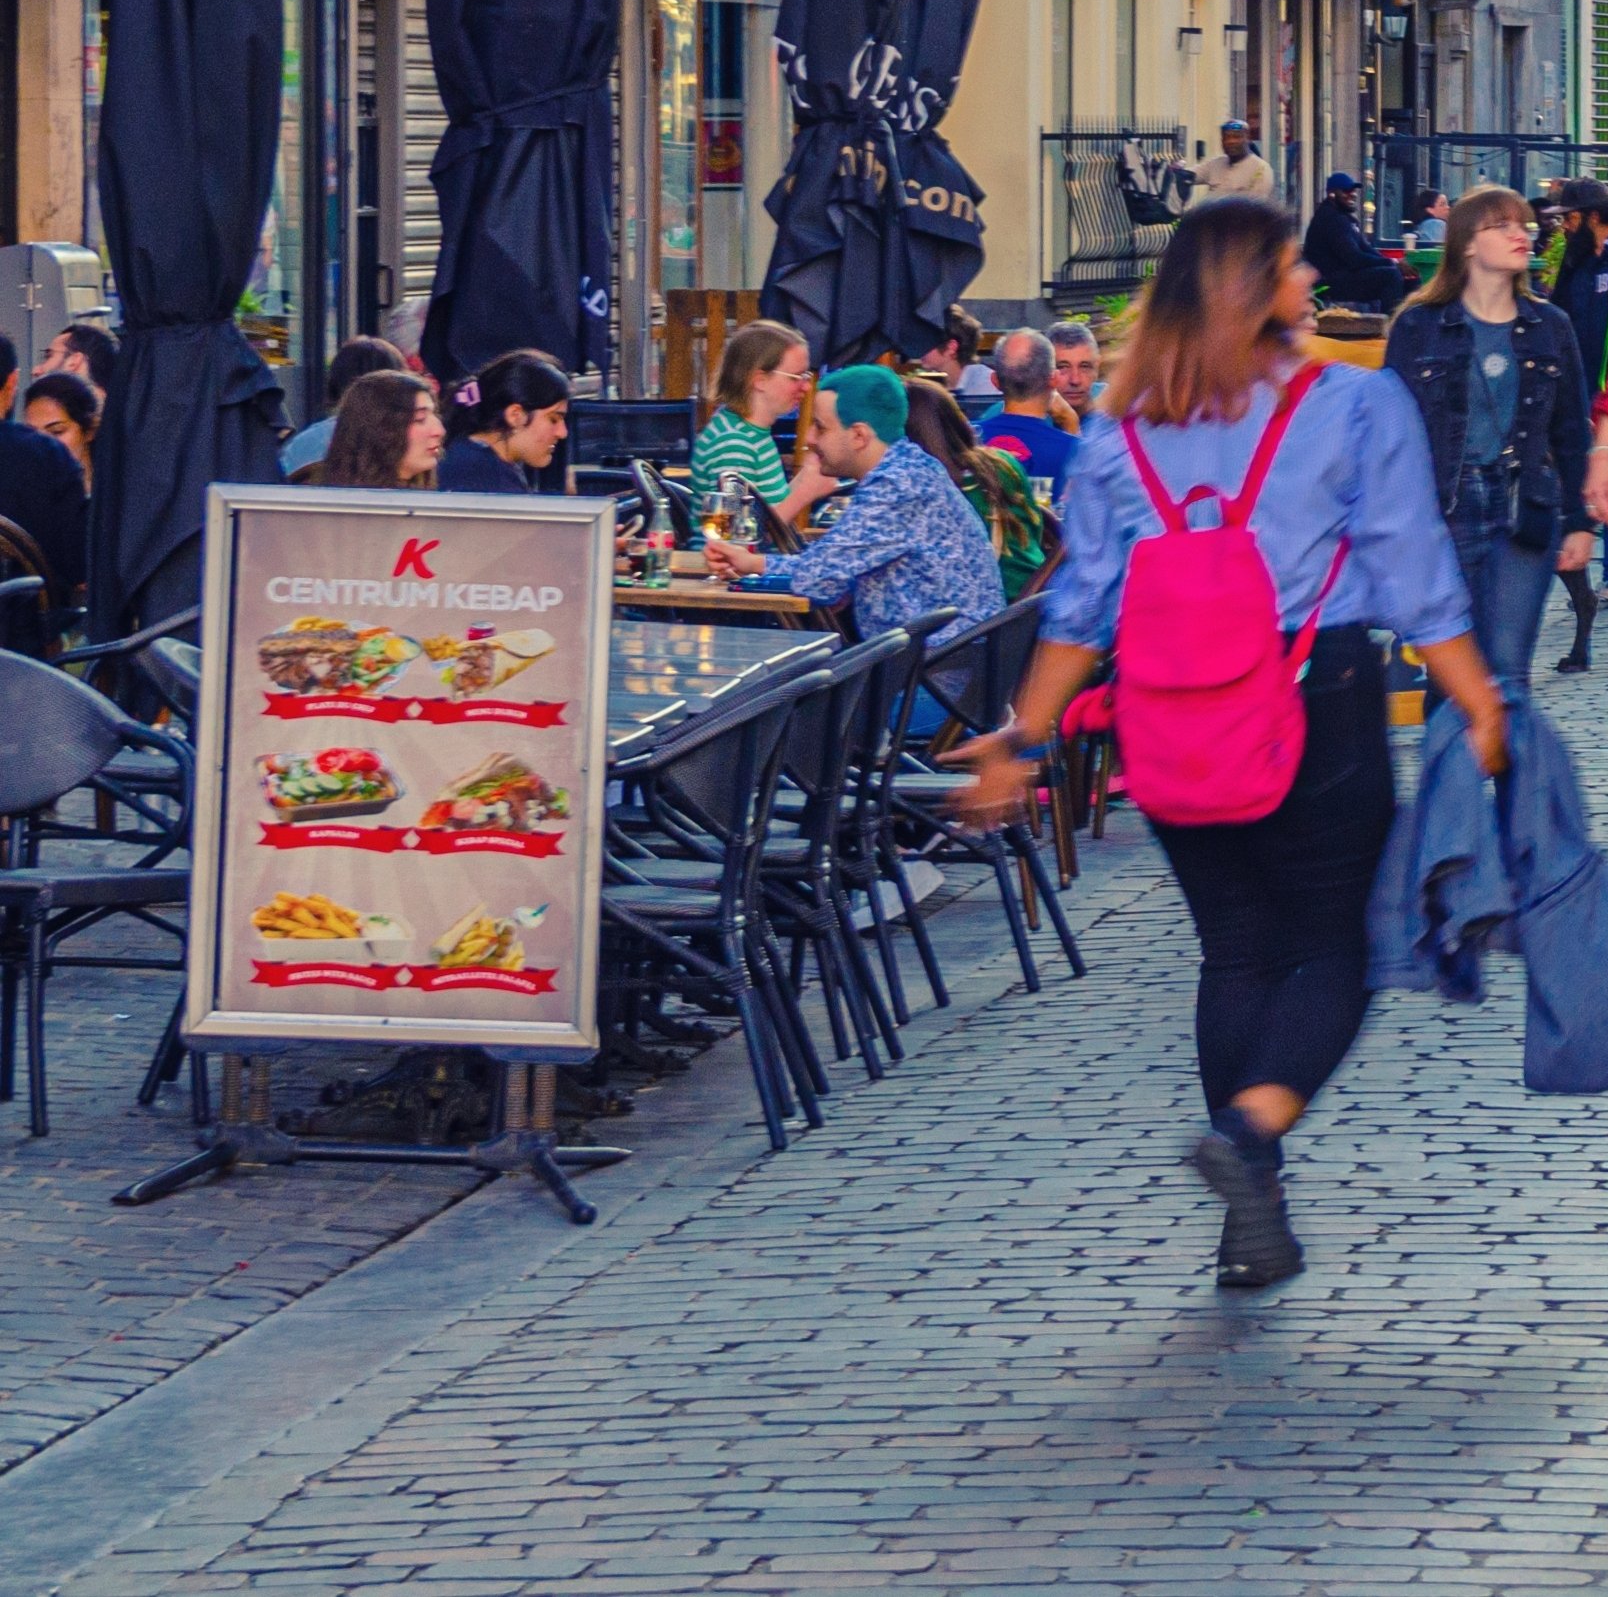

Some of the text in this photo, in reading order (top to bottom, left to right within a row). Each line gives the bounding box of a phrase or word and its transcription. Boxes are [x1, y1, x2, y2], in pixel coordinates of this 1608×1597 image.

[392, 538, 442, 580] K
[266, 576, 564, 613] CENTRUM KEBAP
